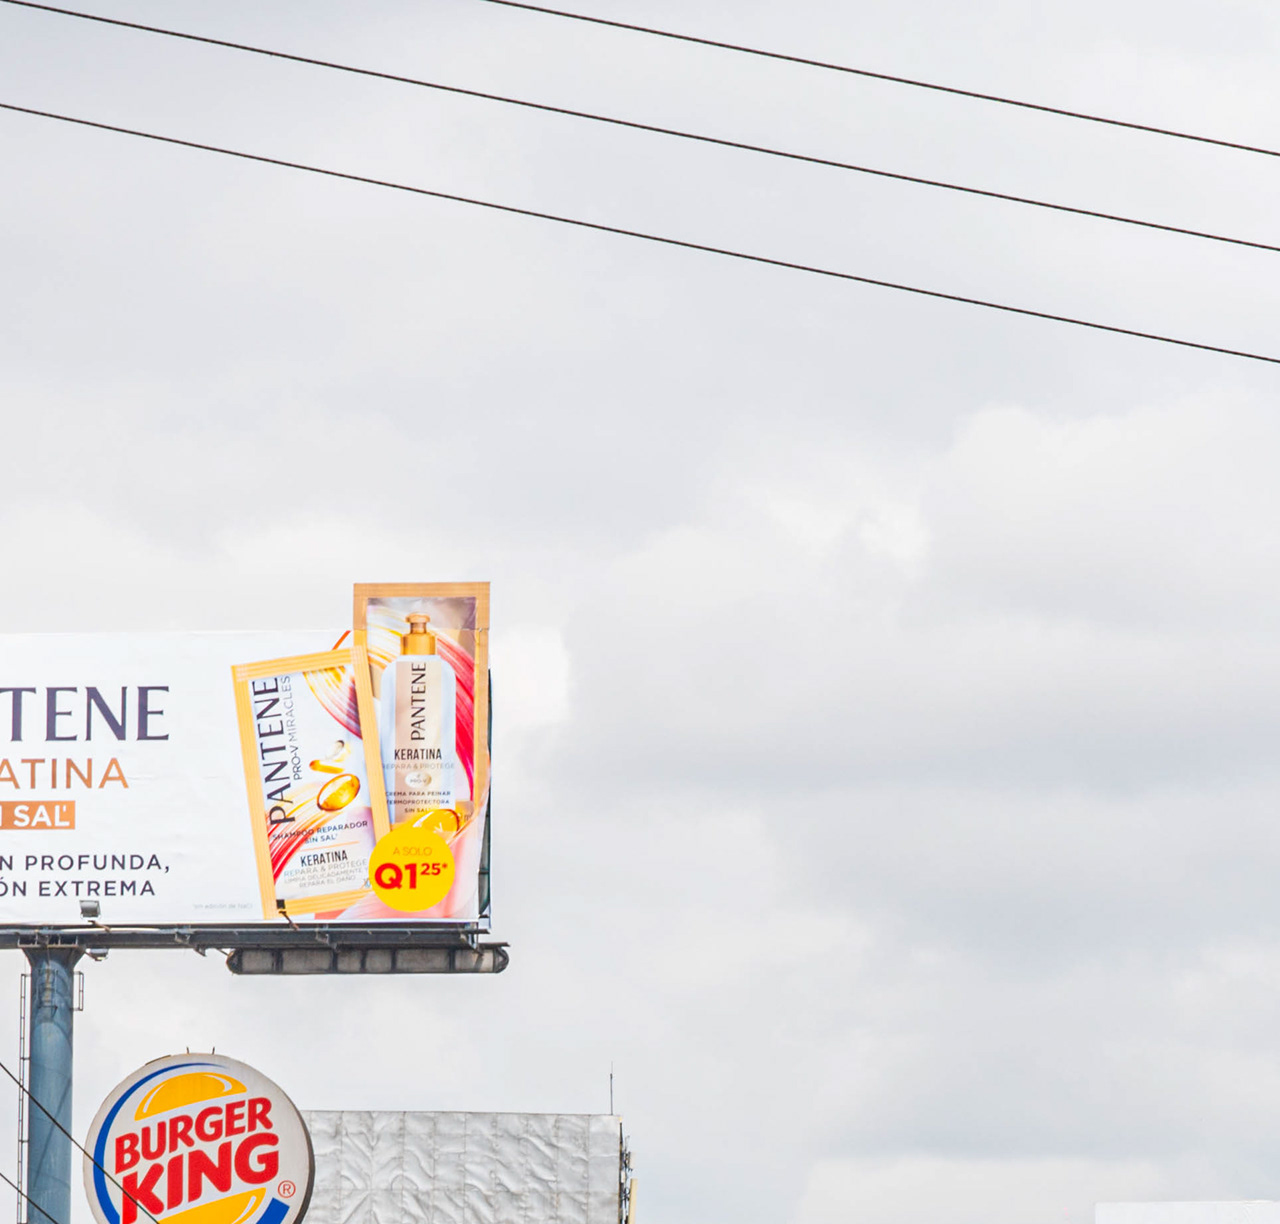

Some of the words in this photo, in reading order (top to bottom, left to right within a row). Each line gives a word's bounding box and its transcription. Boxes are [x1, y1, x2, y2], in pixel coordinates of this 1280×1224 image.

[280, 675, 298, 742] MIRACLES
[411, 663, 426, 741] PANTENE
[252, 677, 296, 825] PANTENE
[394, 748, 442, 760] KERATINA
[290, 745, 303, 781] PRO-V
[272, 828, 315, 841] SHAMPOO
[316, 820, 368, 834] REPARADOR
[300, 850, 348, 867] KERATINA
[393, 847, 401, 857] A
[403, 847, 432, 857] SOLO
[25, 854, 170, 874] PROFUNDA,
[284, 867, 319, 877] REPARA
[328, 859, 368, 870] PROTEGE
[39, 880, 155, 897] EXTREMA
[115, 1097, 273, 1175] BURGER
